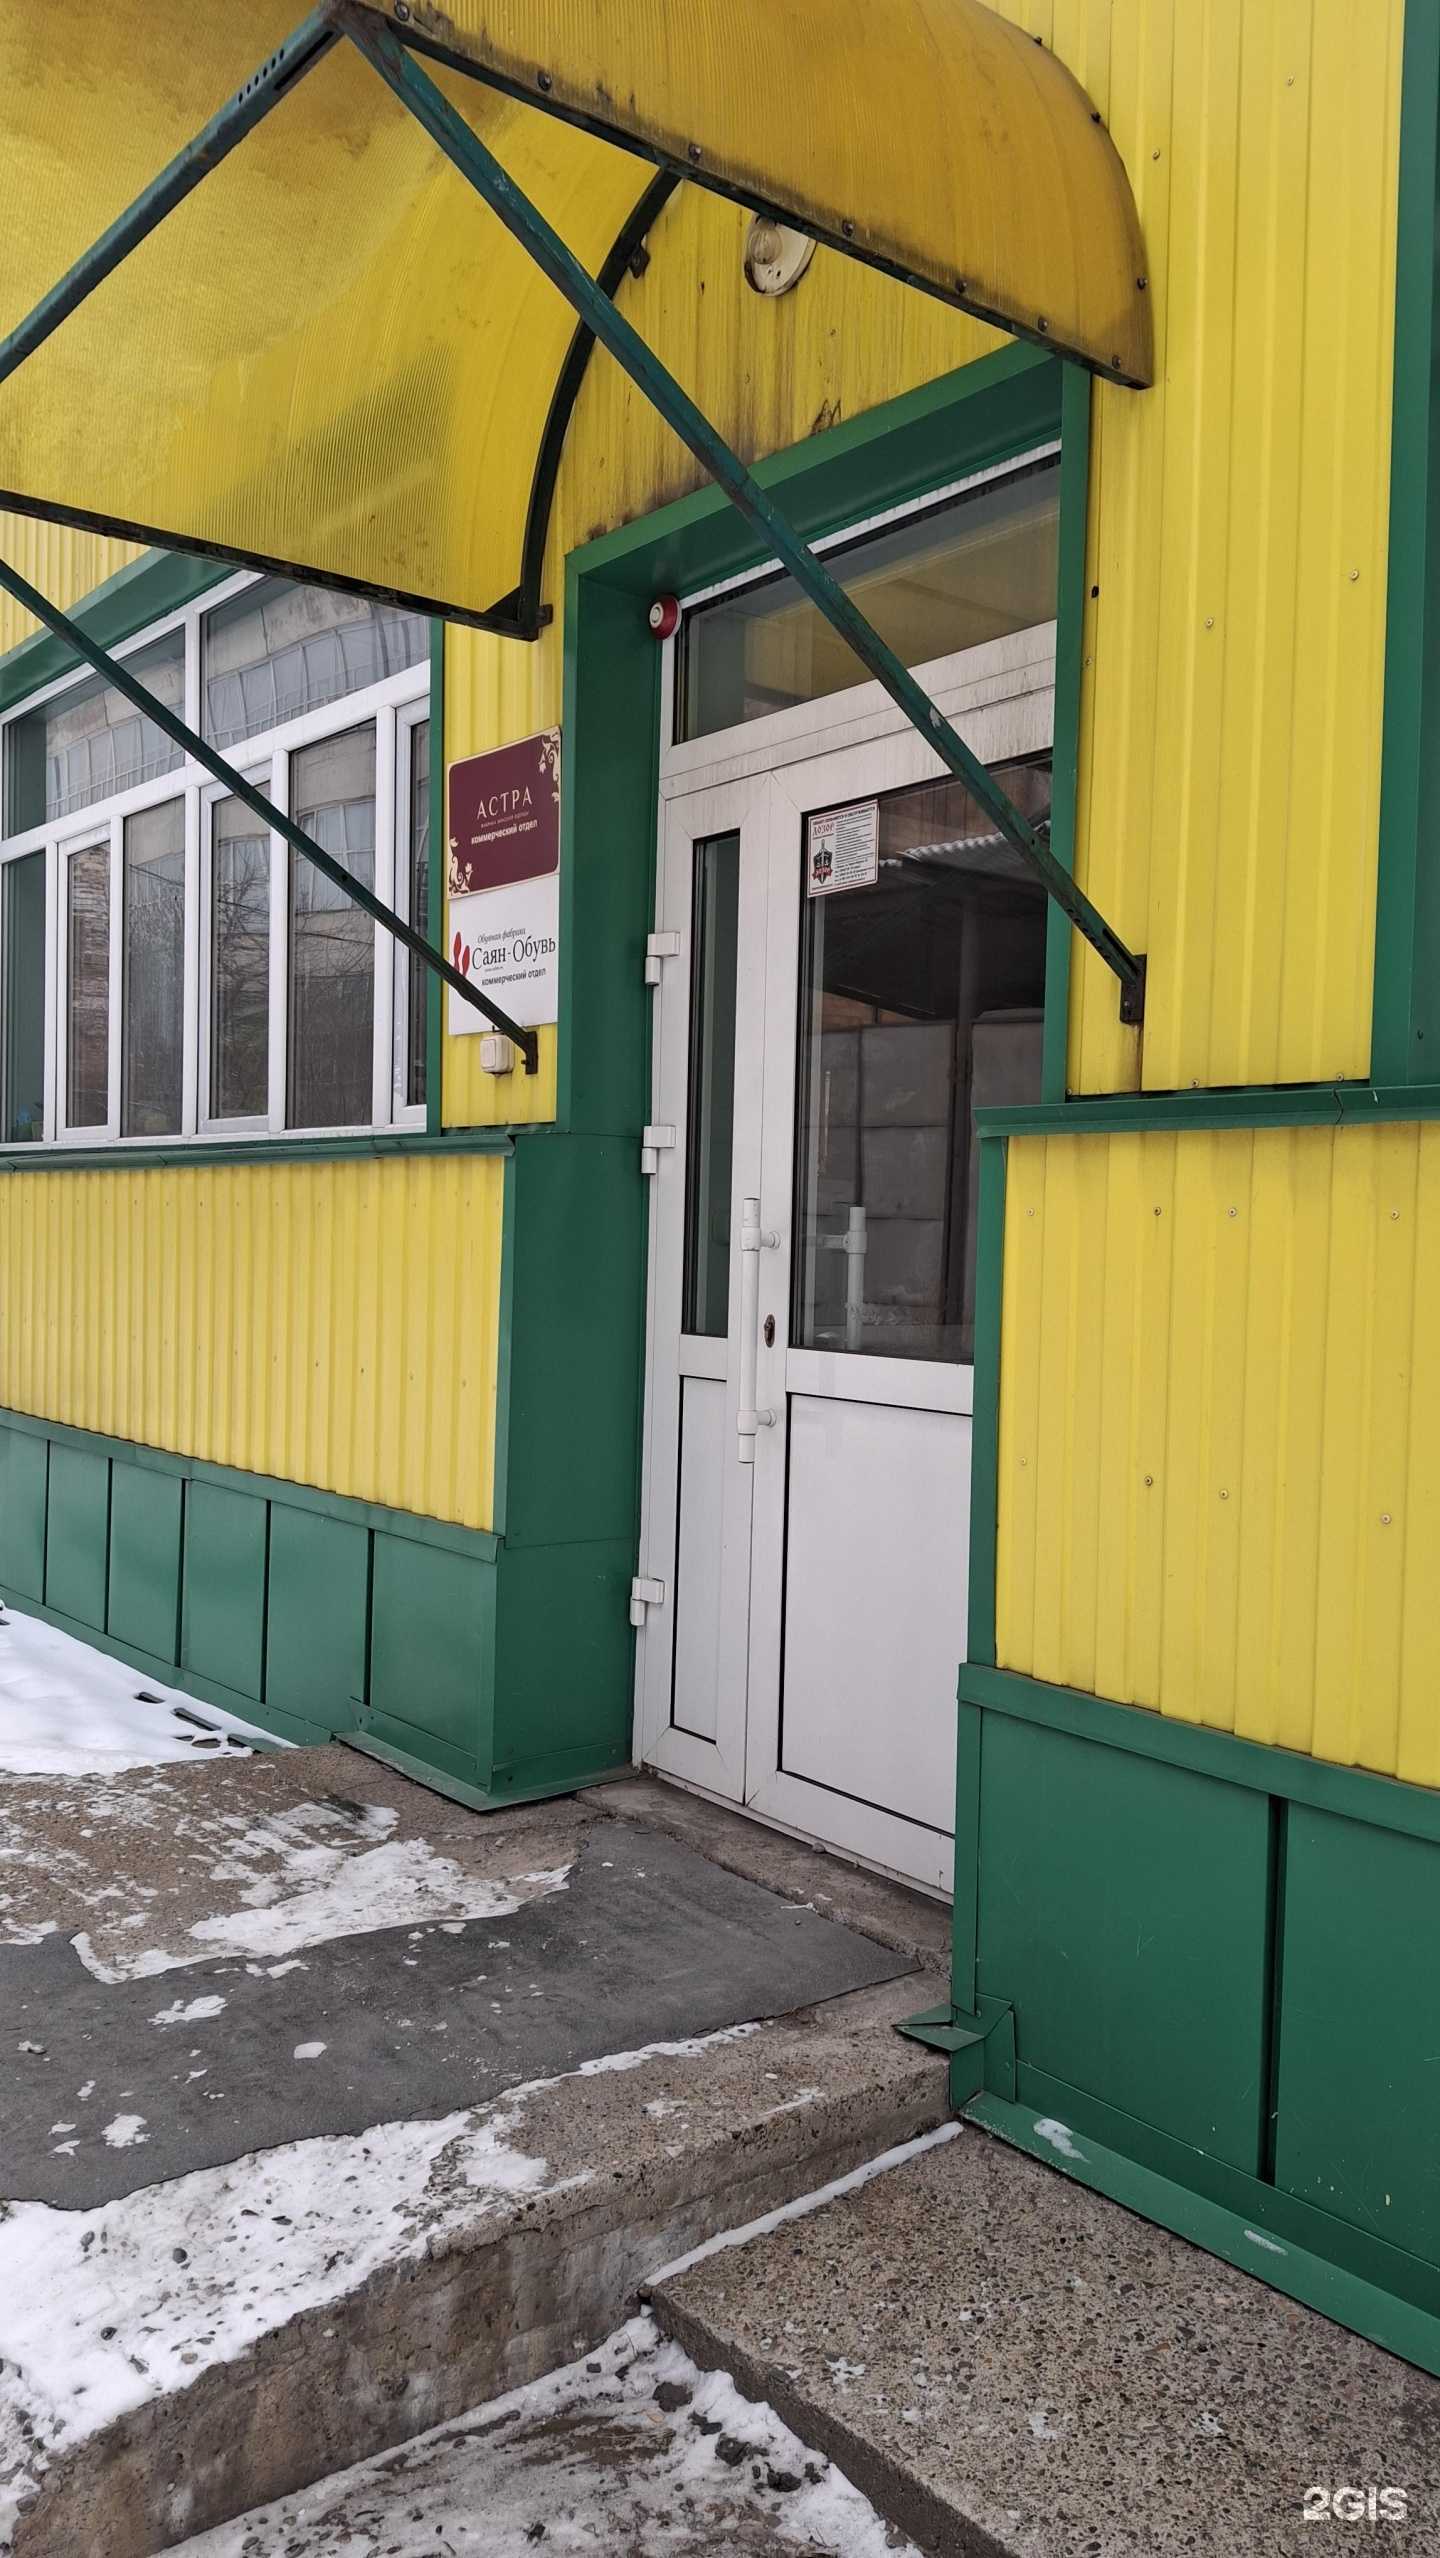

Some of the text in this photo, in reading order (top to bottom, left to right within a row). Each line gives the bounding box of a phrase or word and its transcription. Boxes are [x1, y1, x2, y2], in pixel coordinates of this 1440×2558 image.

[476, 785, 533, 820] АСТРА
[471, 823, 517, 845] коммерческий
[518, 819, 538, 833] отдел
[481, 969, 527, 986] коммерческий
[528, 968, 546, 979] отдел
